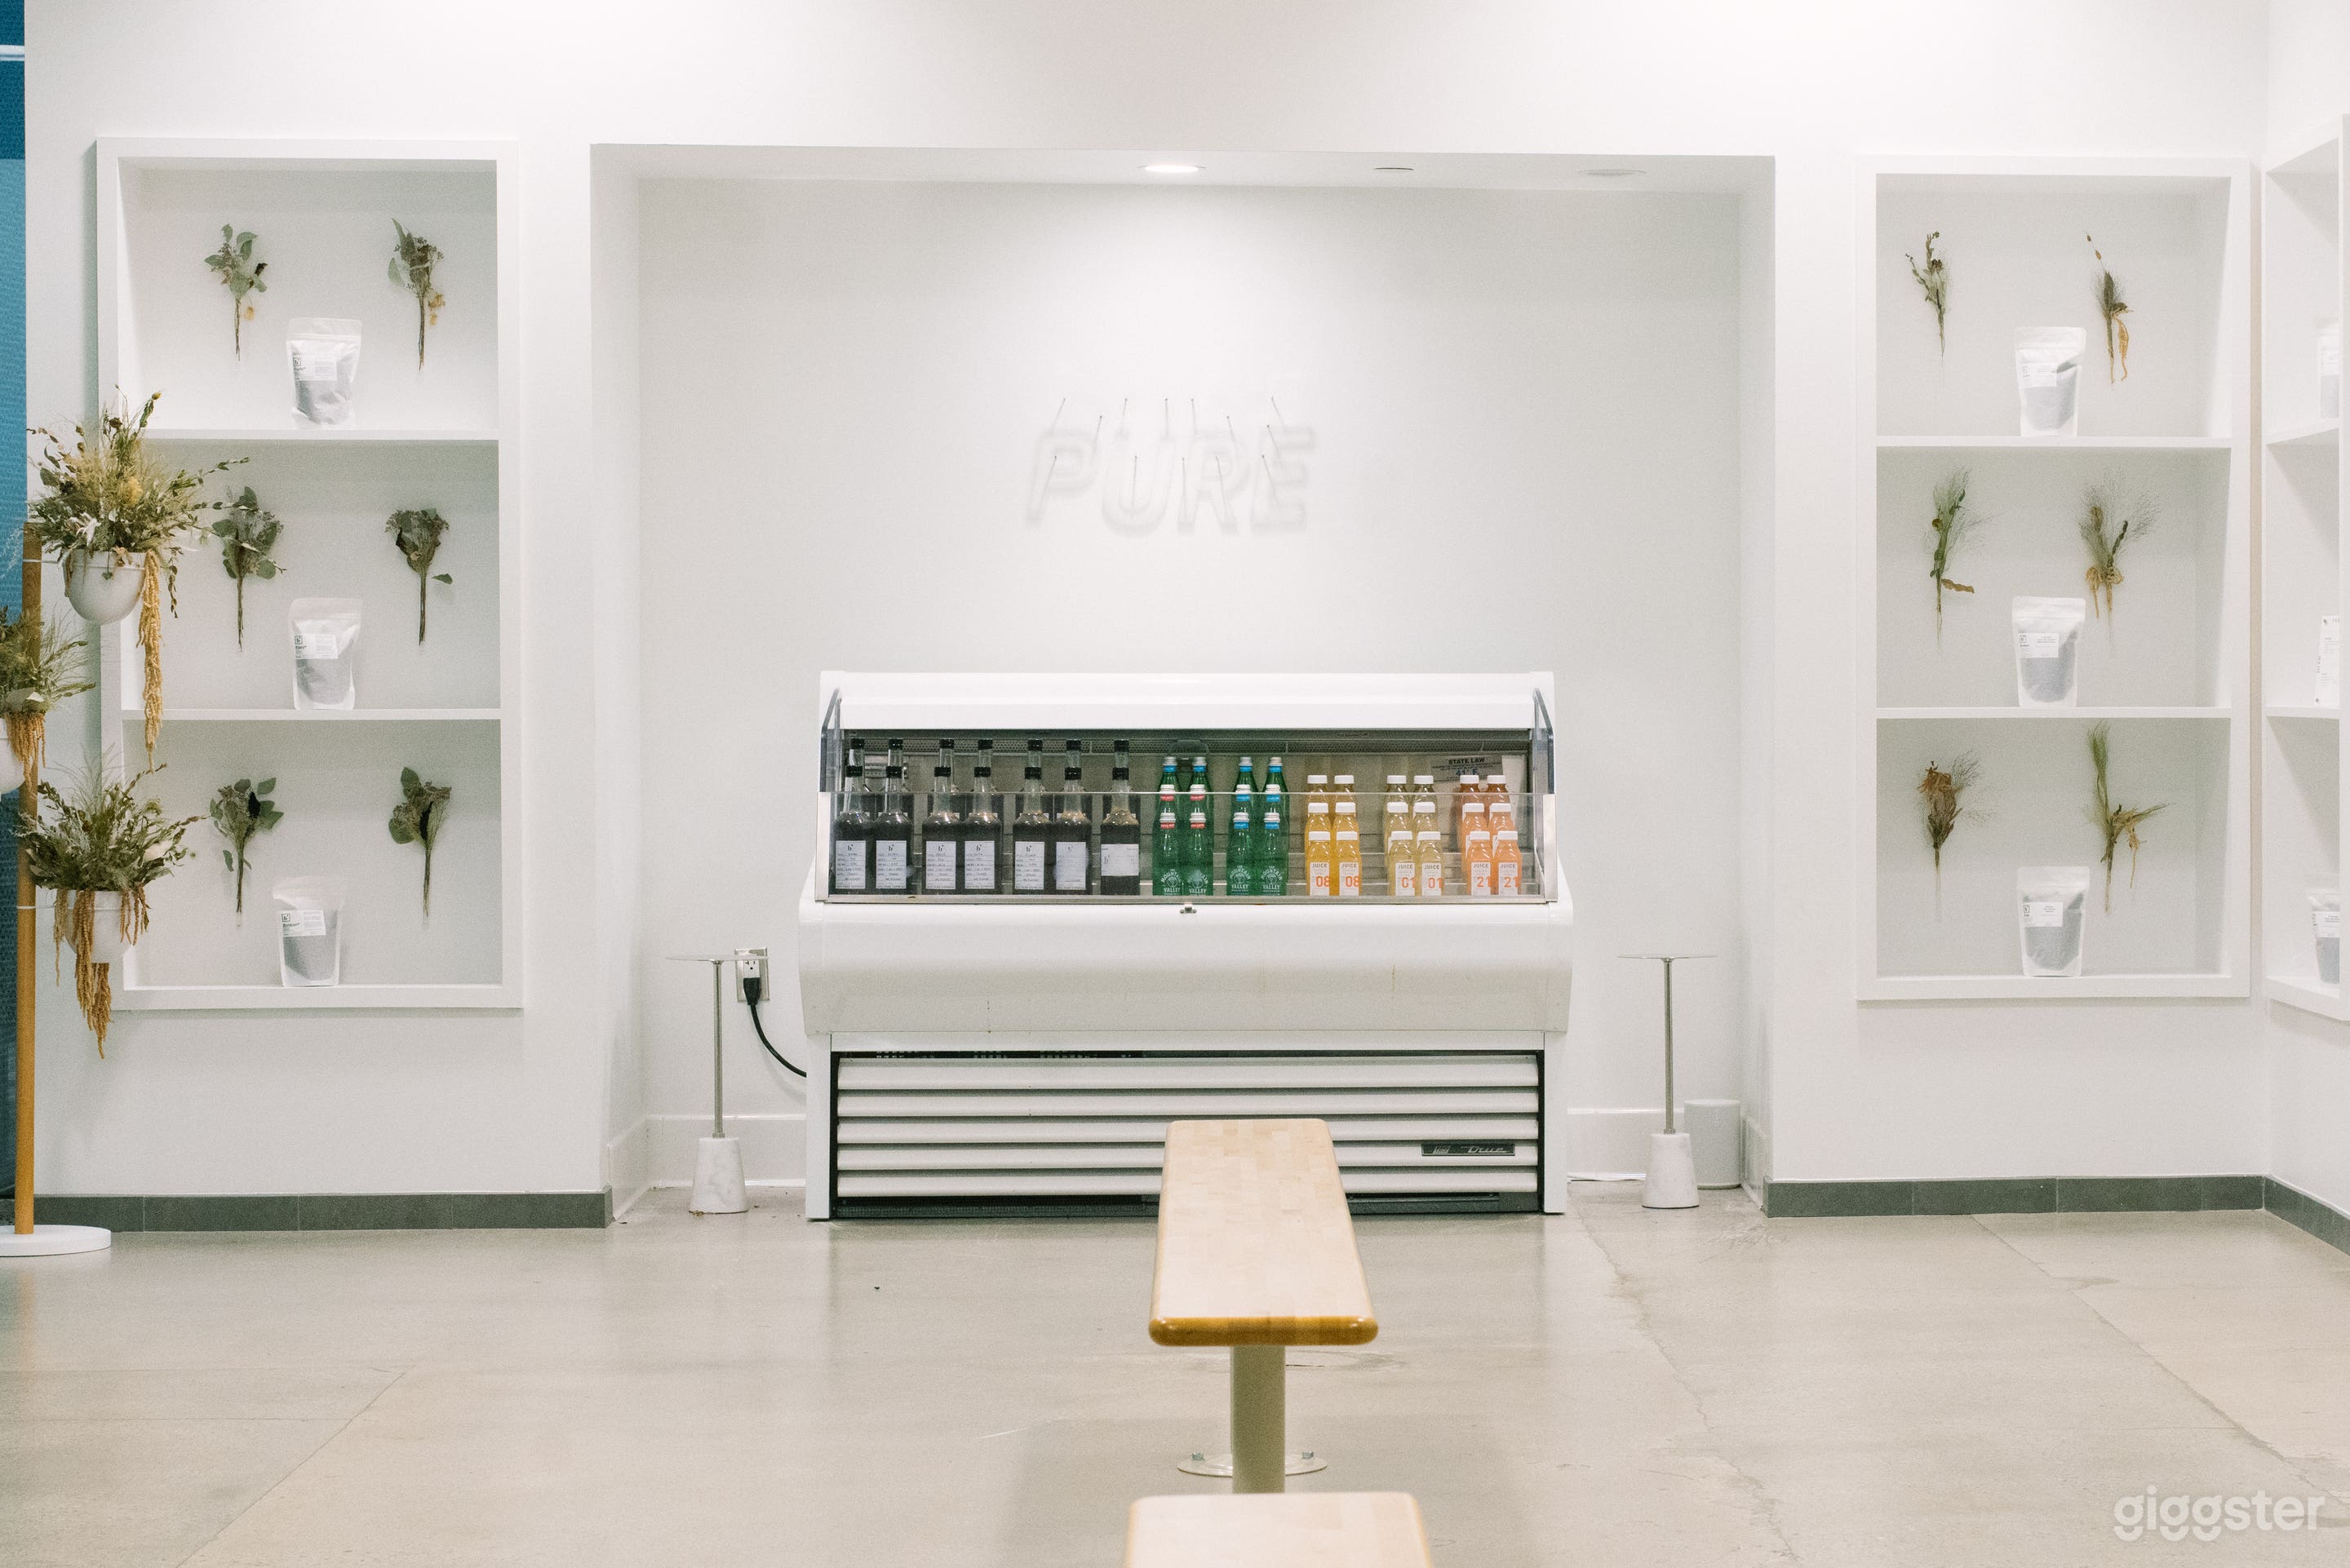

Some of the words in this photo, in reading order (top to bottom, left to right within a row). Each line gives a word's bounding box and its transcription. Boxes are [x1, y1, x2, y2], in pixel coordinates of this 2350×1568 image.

[1026, 425, 1318, 537] PURE
[1230, 867, 1251, 879] MOUNTAIN
[1261, 869, 1283, 881] MOUNTAIN
[1346, 875, 1360, 888] 08
[1428, 878, 1443, 888] 01
[1477, 876, 1492, 888] 21
[1504, 877, 1519, 888] 21
[1461, 1145, 1507, 1154] True
